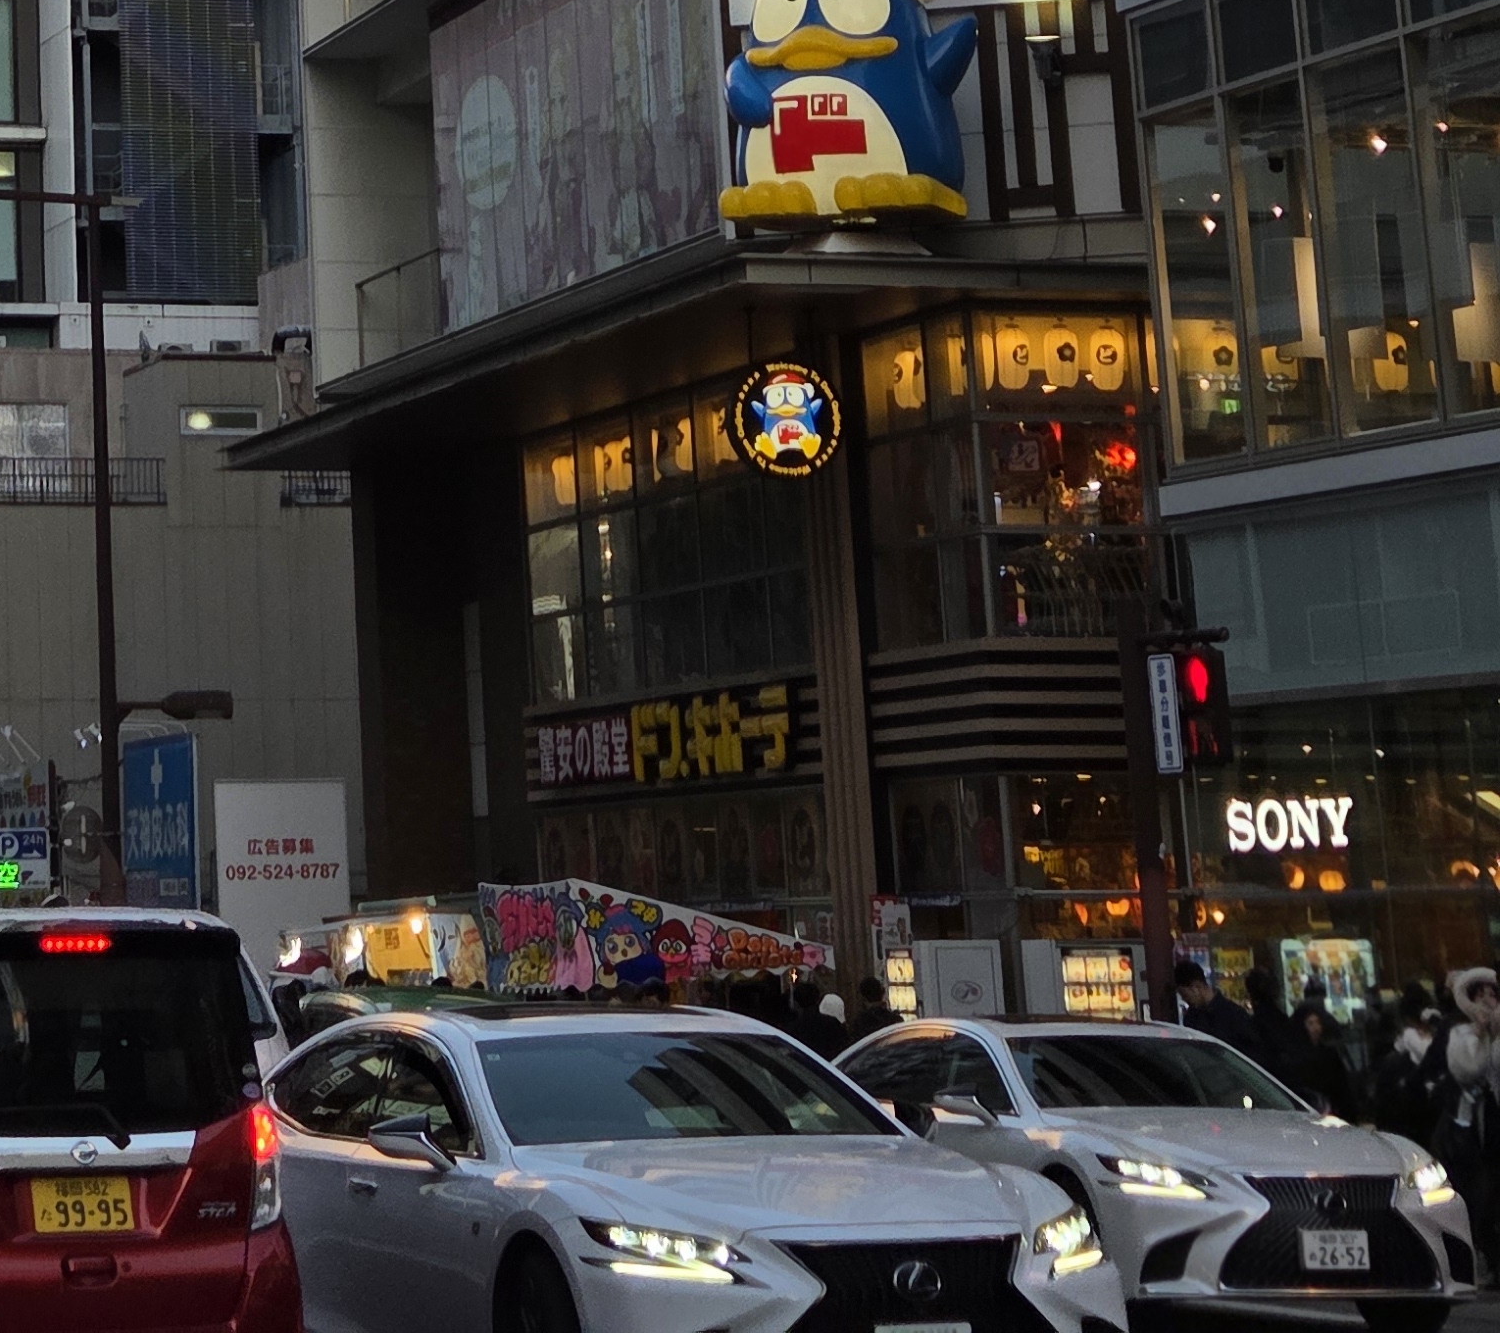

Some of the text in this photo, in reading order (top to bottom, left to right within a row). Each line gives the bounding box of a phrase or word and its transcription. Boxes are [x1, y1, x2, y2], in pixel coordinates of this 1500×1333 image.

[538, 717, 630, 784] 驚安の殿堂
[22, 834, 44, 846] 24h
[127, 801, 188, 861] 天神皮ふ科
[247, 838, 314, 856] 広告募集
[1226, 795, 1353, 854] SONY
